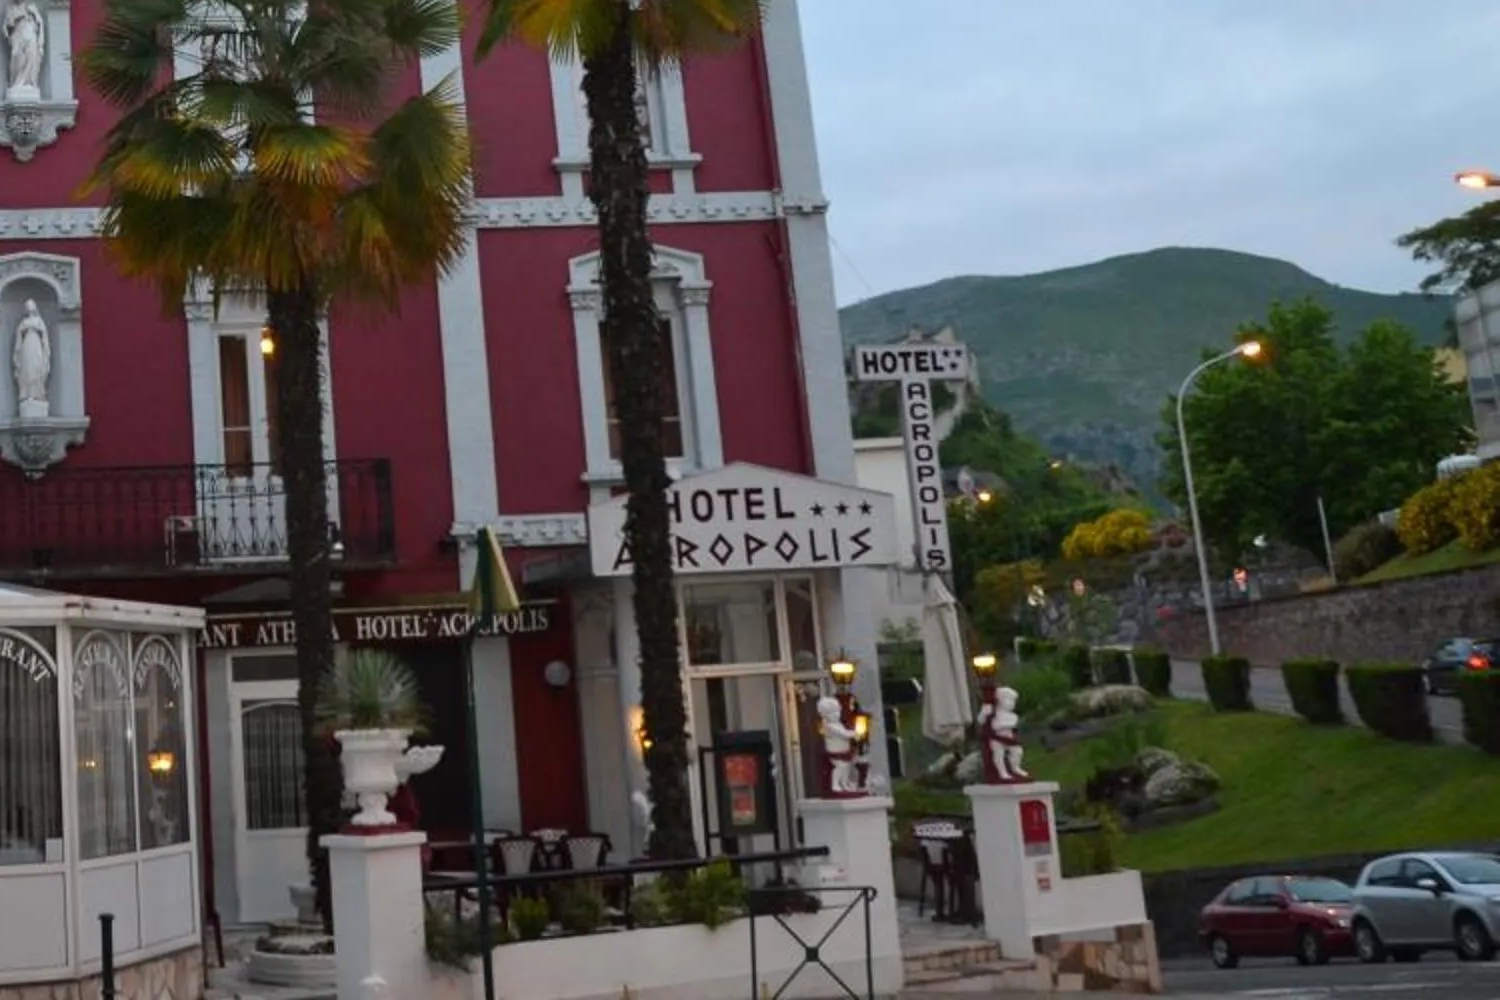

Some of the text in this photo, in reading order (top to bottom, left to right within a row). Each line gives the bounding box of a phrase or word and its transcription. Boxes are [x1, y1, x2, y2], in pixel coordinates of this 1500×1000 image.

[863, 351, 945, 375] HOTEL
[907, 382, 946, 568] ACROPOLIS
[663, 487, 796, 523] HOTEL
[612, 528, 873, 571] AROPOLIS
[197, 623, 242, 649] ANT
[256, 616, 340, 645] ATHA
[355, 613, 428, 641] HOTEL
